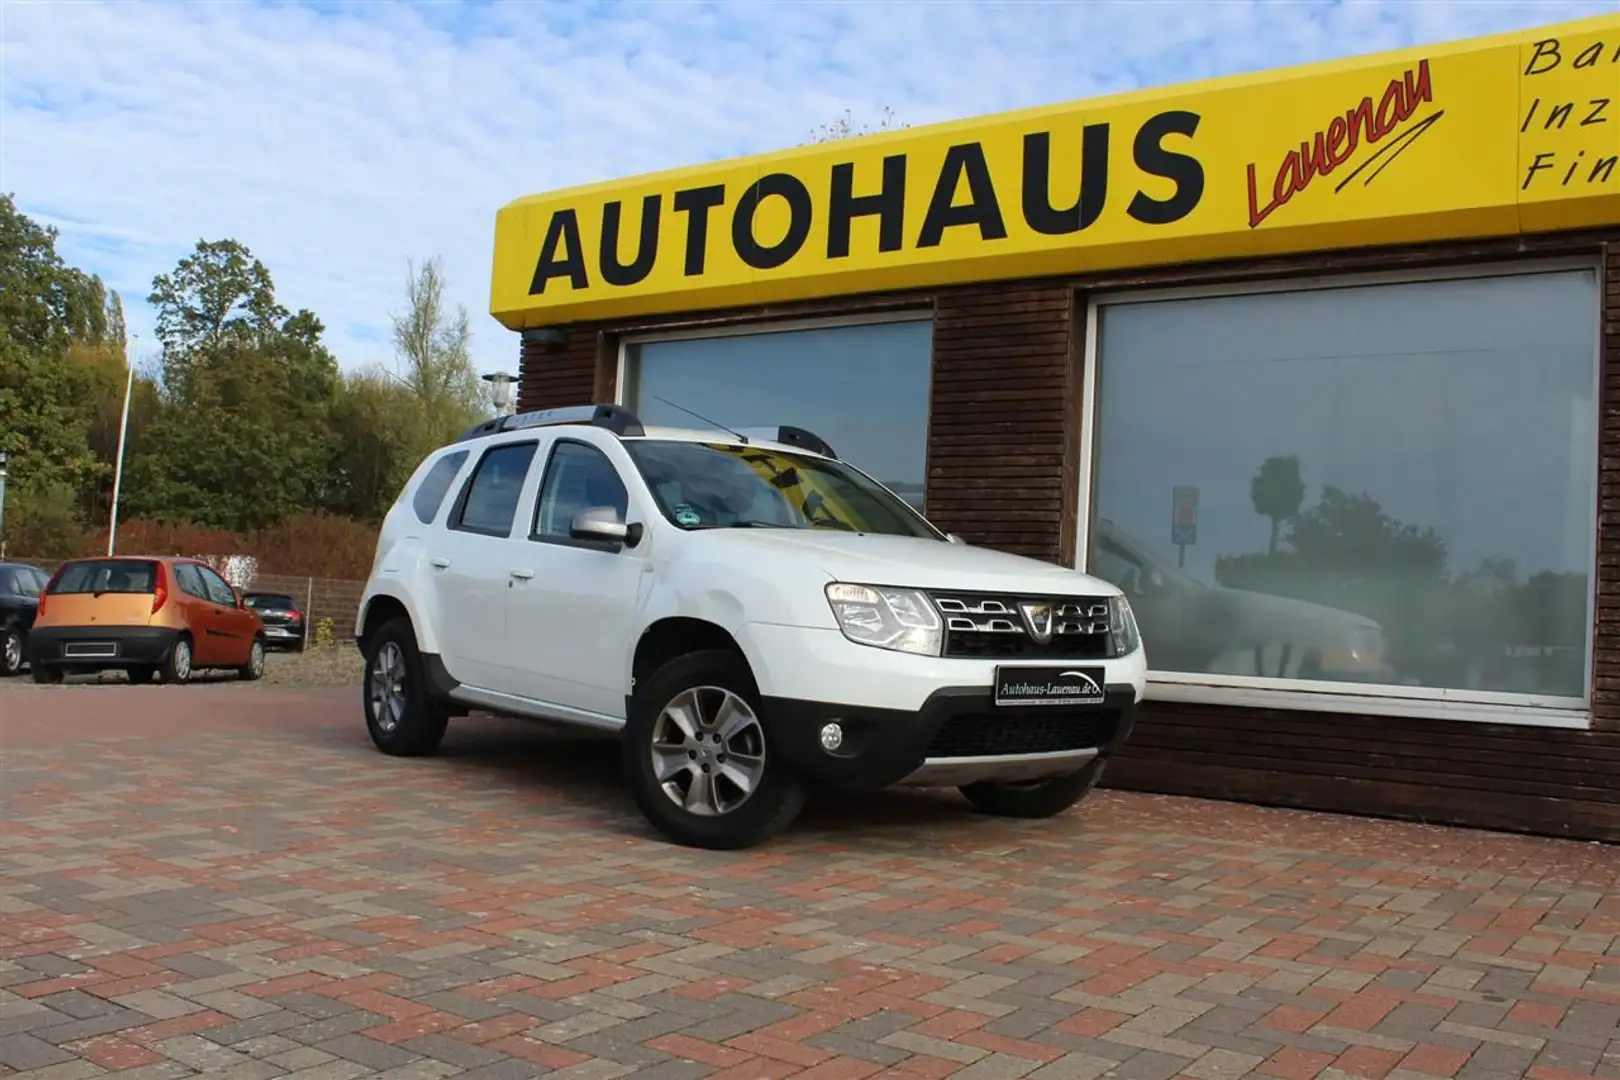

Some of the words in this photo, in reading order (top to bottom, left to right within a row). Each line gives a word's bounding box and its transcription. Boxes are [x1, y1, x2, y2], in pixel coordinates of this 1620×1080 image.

[1524, 38, 1620, 76] Ba
[527, 110, 1206, 296] AUTOHAUS
[1246, 58, 1433, 228] Lauenau
[1521, 150, 1619, 191] Fin
